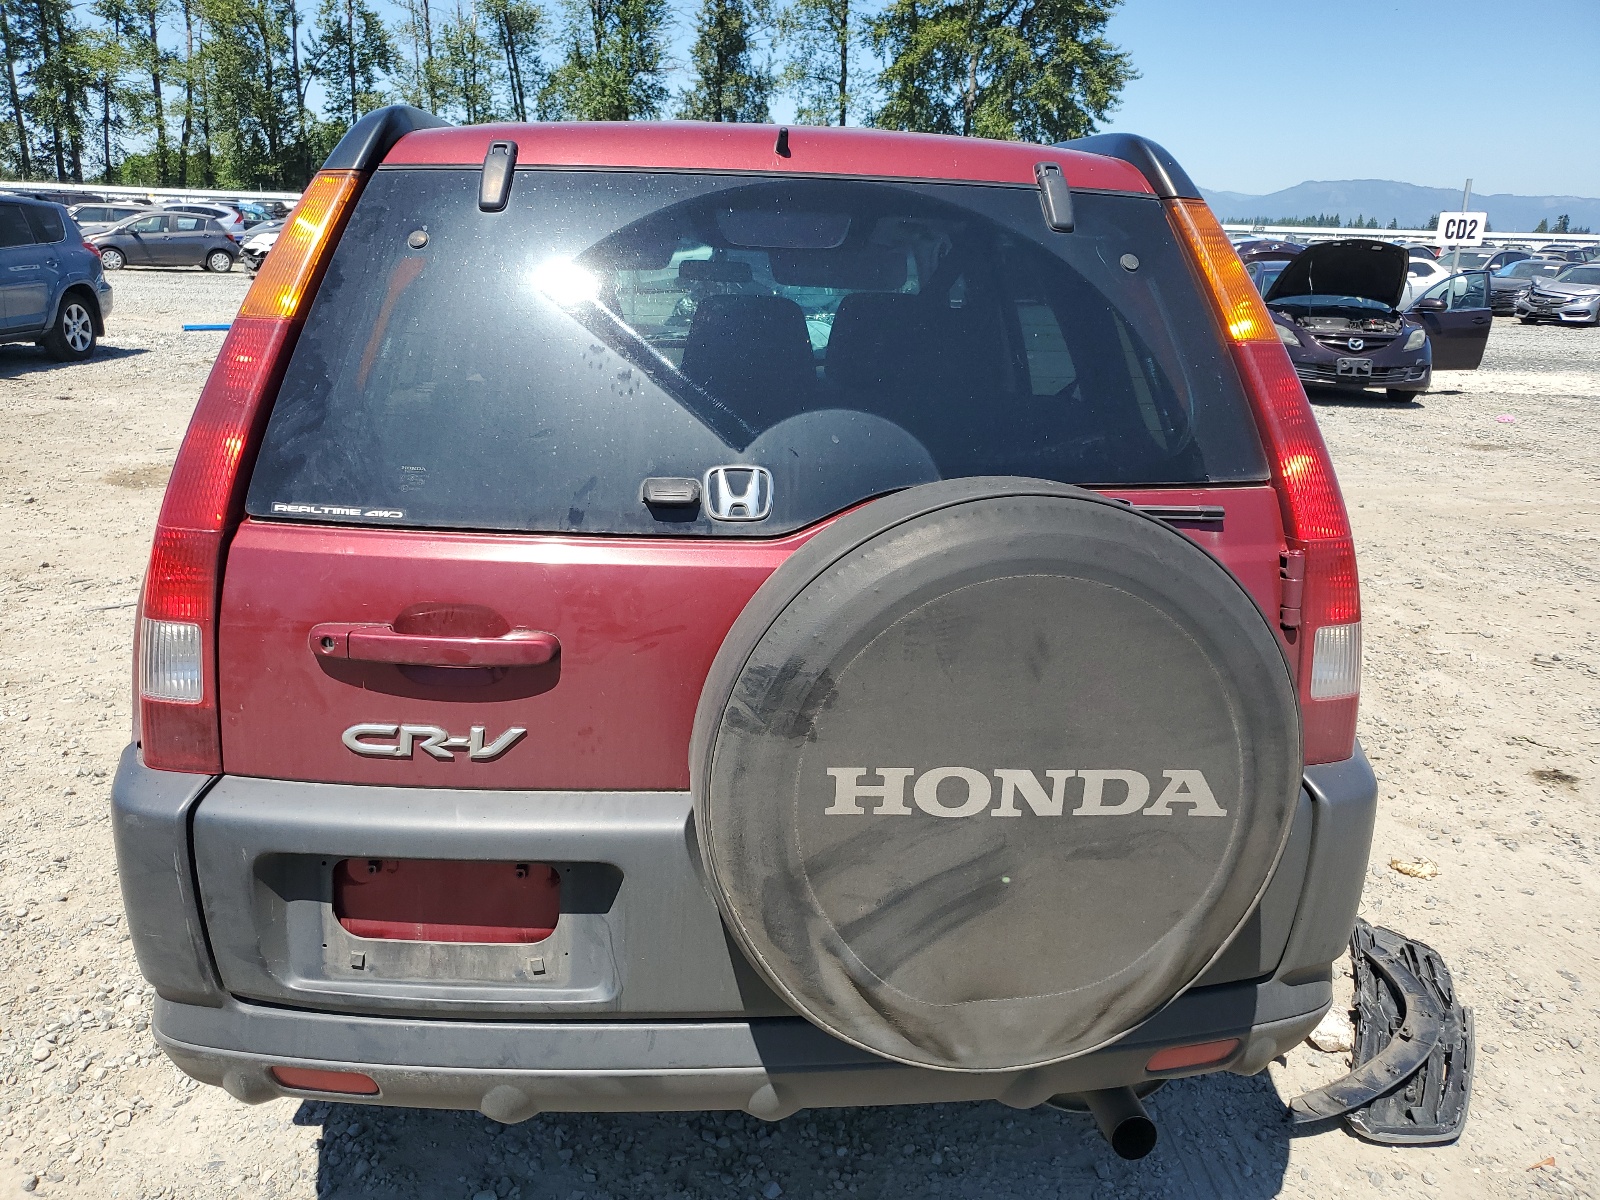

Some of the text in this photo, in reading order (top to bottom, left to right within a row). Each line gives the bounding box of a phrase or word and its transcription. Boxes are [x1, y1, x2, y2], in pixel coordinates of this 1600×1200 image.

[1445, 219, 1478, 239] CD2
[364, 510, 403, 518] 4WD
[341, 723, 528, 761] CR-V
[824, 766, 1228, 818] HONDA
